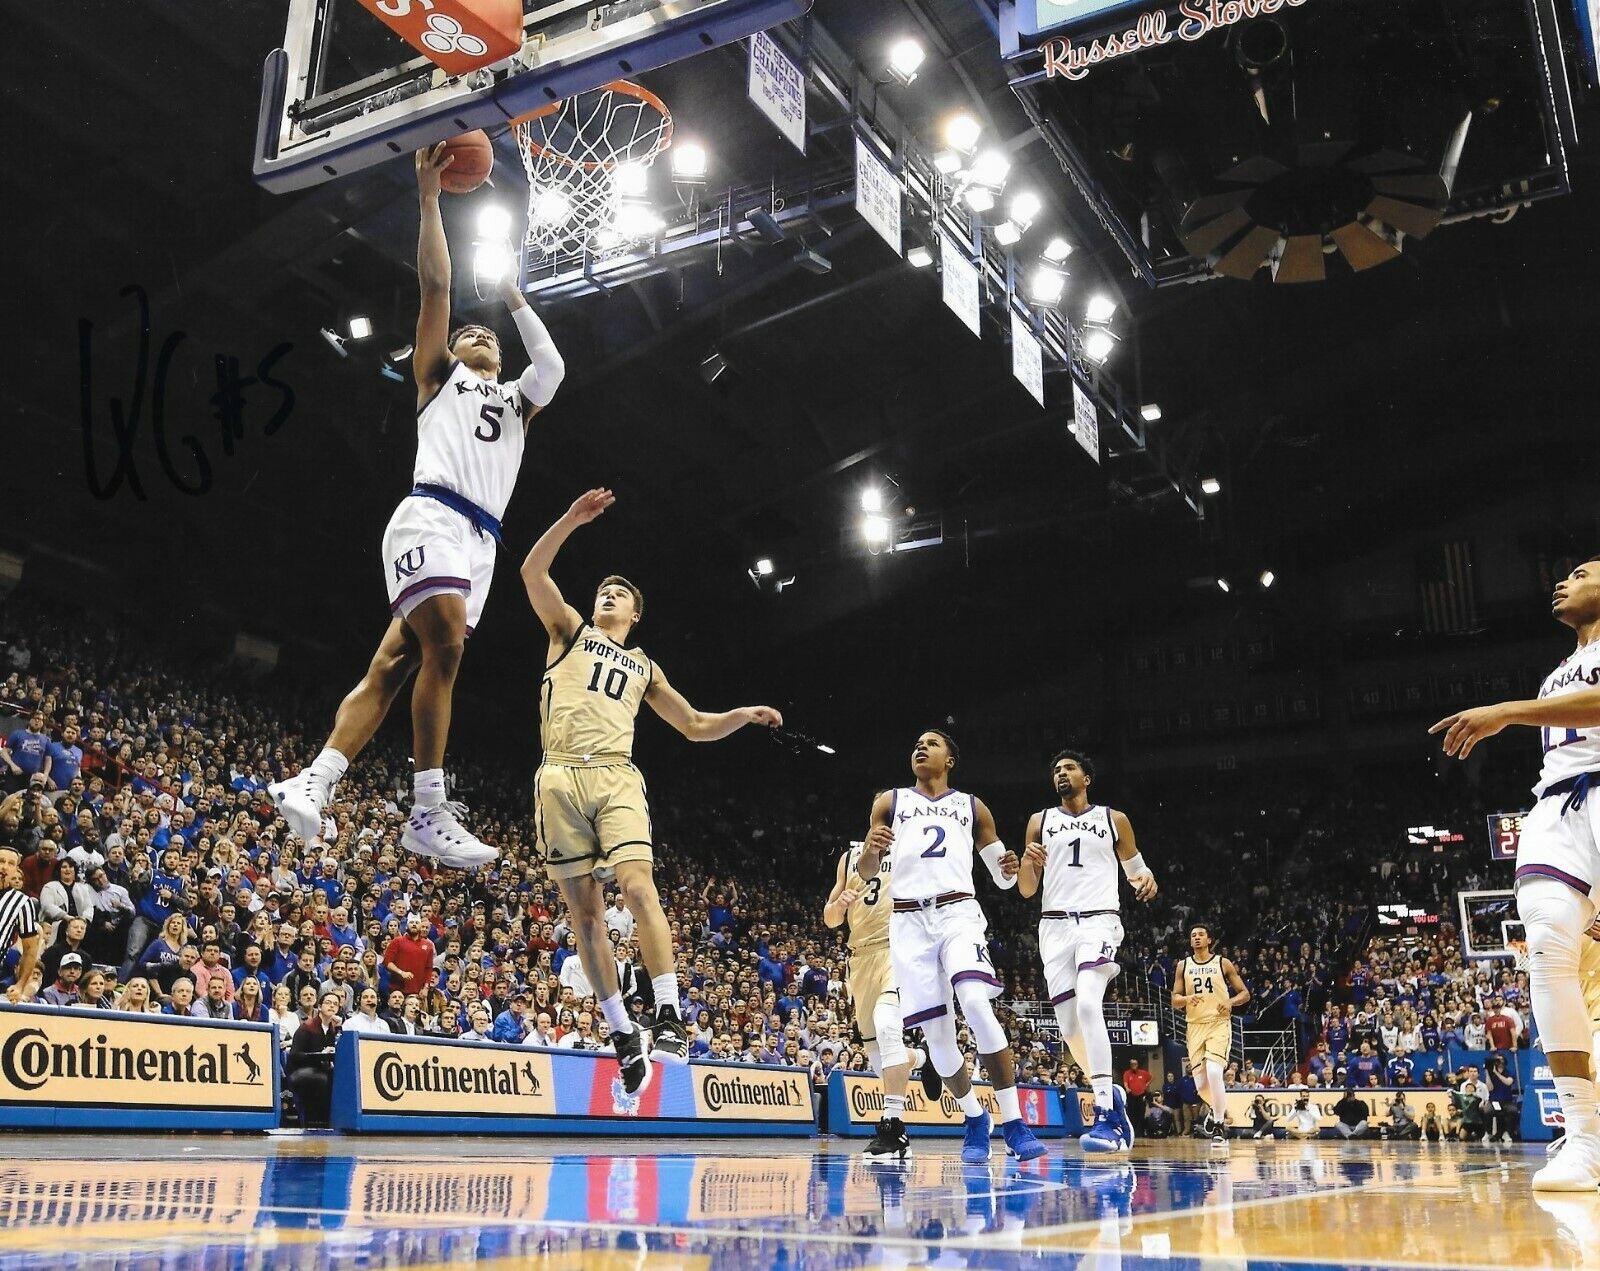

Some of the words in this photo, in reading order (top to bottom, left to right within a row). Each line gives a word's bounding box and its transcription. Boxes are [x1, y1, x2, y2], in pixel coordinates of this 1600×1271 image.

[1038, 10, 1172, 81] Russell
[1177, 0, 1304, 42] Stove
[753, 43, 801, 107] CHAMPIONS
[474, 404, 504, 442] 5
[394, 545, 426, 584] KU
[583, 639, 644, 676] WOFFORD
[587, 662, 628, 700] 10
[897, 806, 969, 827] KANSAS
[1047, 821, 1107, 839] KANSAS
[920, 825, 947, 858] 2
[1067, 837, 1083, 868] 1
[1501, 832, 1521, 854] 2
[863, 877, 881, 906] 3
[1189, 967, 1217, 975] WOFFORD
[1193, 977, 1213, 994] 24
[1036, 1018, 1060, 1026] KANSA
[1107, 1020, 1127, 1028] GUEST
[2, 1027, 230, 1091] Continental
[373, 1051, 520, 1101] Continental
[703, 1073, 791, 1112] Continental
